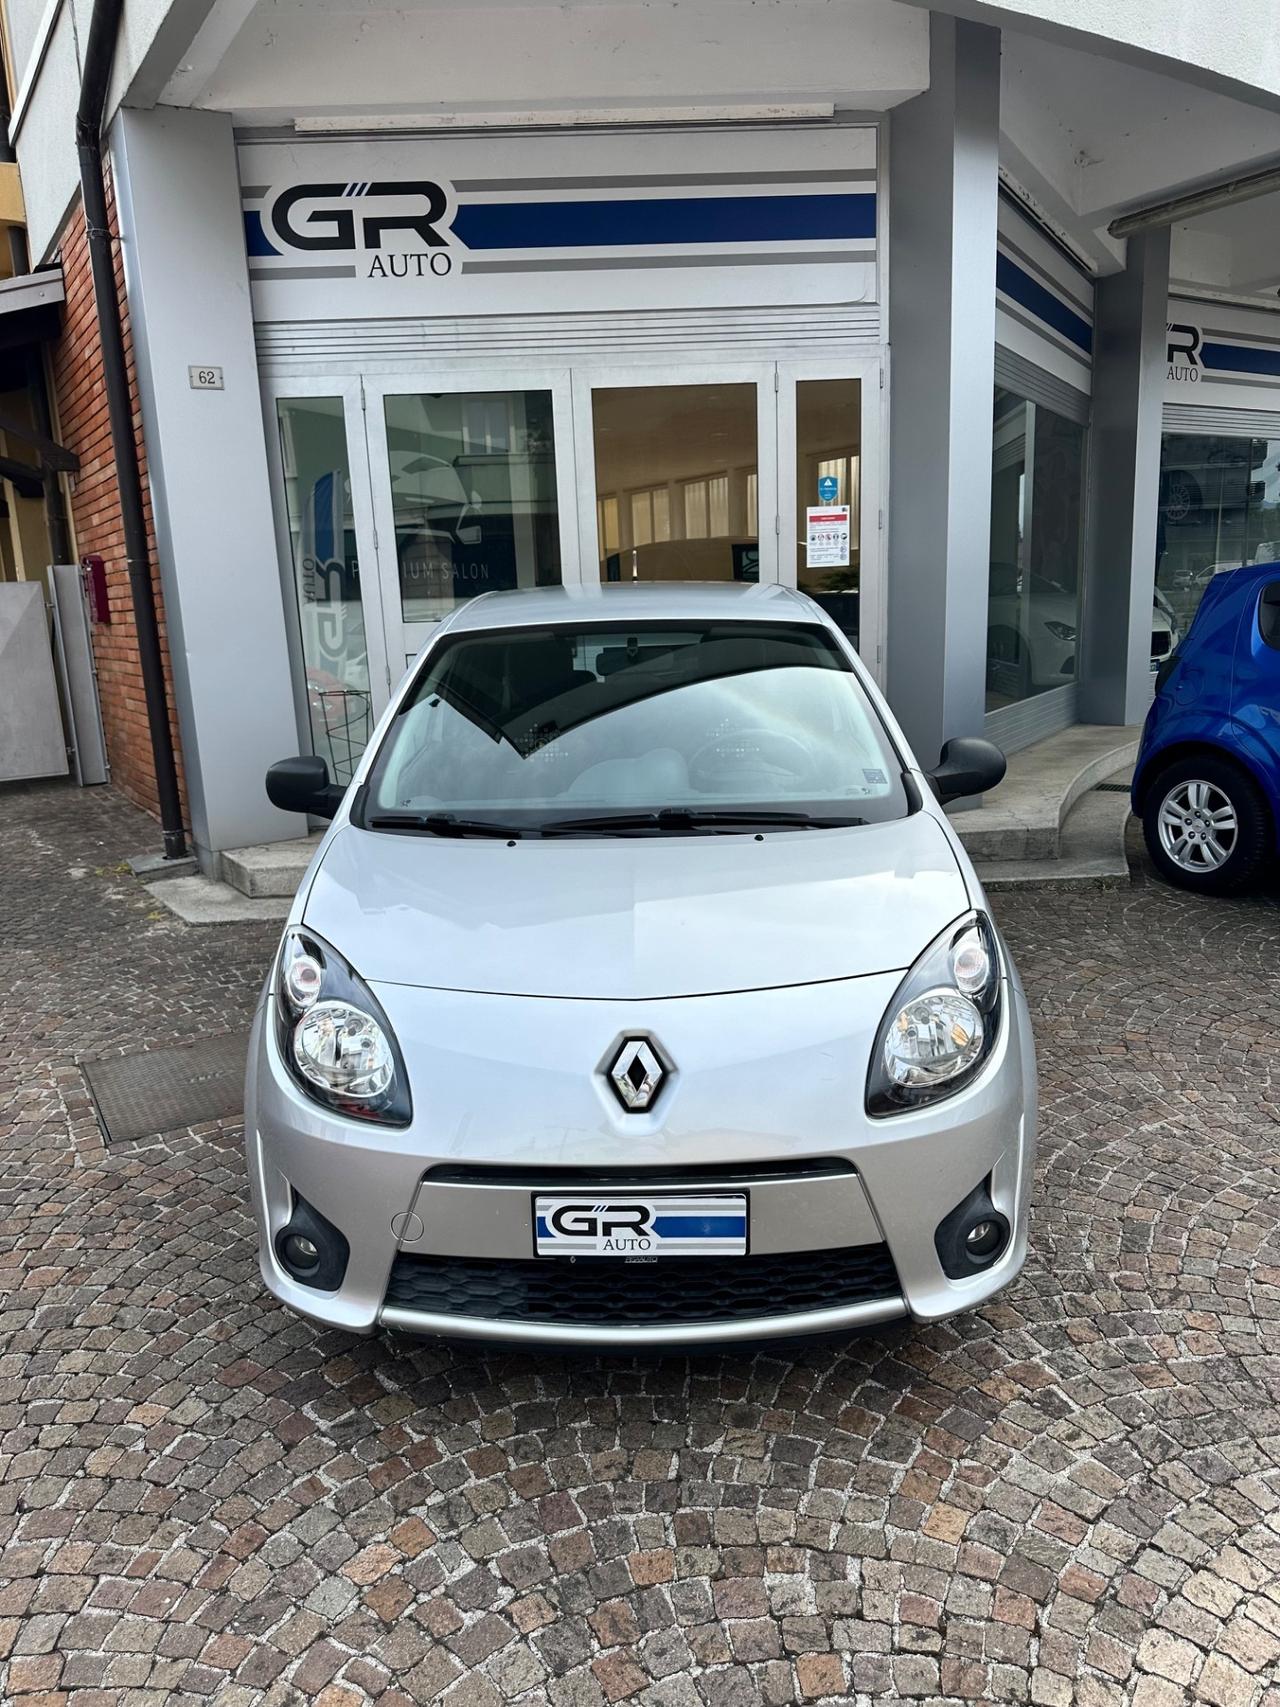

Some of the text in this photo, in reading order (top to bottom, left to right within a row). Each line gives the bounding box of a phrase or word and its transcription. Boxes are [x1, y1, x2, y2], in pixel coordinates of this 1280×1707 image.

[271, 180, 450, 251] GR
[367, 252, 451, 278] AUTO
[1166, 322, 1200, 366] R
[198, 370, 216, 384] 62
[1166, 365, 1199, 383] AUTO
[351, 560, 489, 580] PIUM SALON
[551, 1204, 651, 1237] GR
[603, 1238, 651, 1251] AUTO
